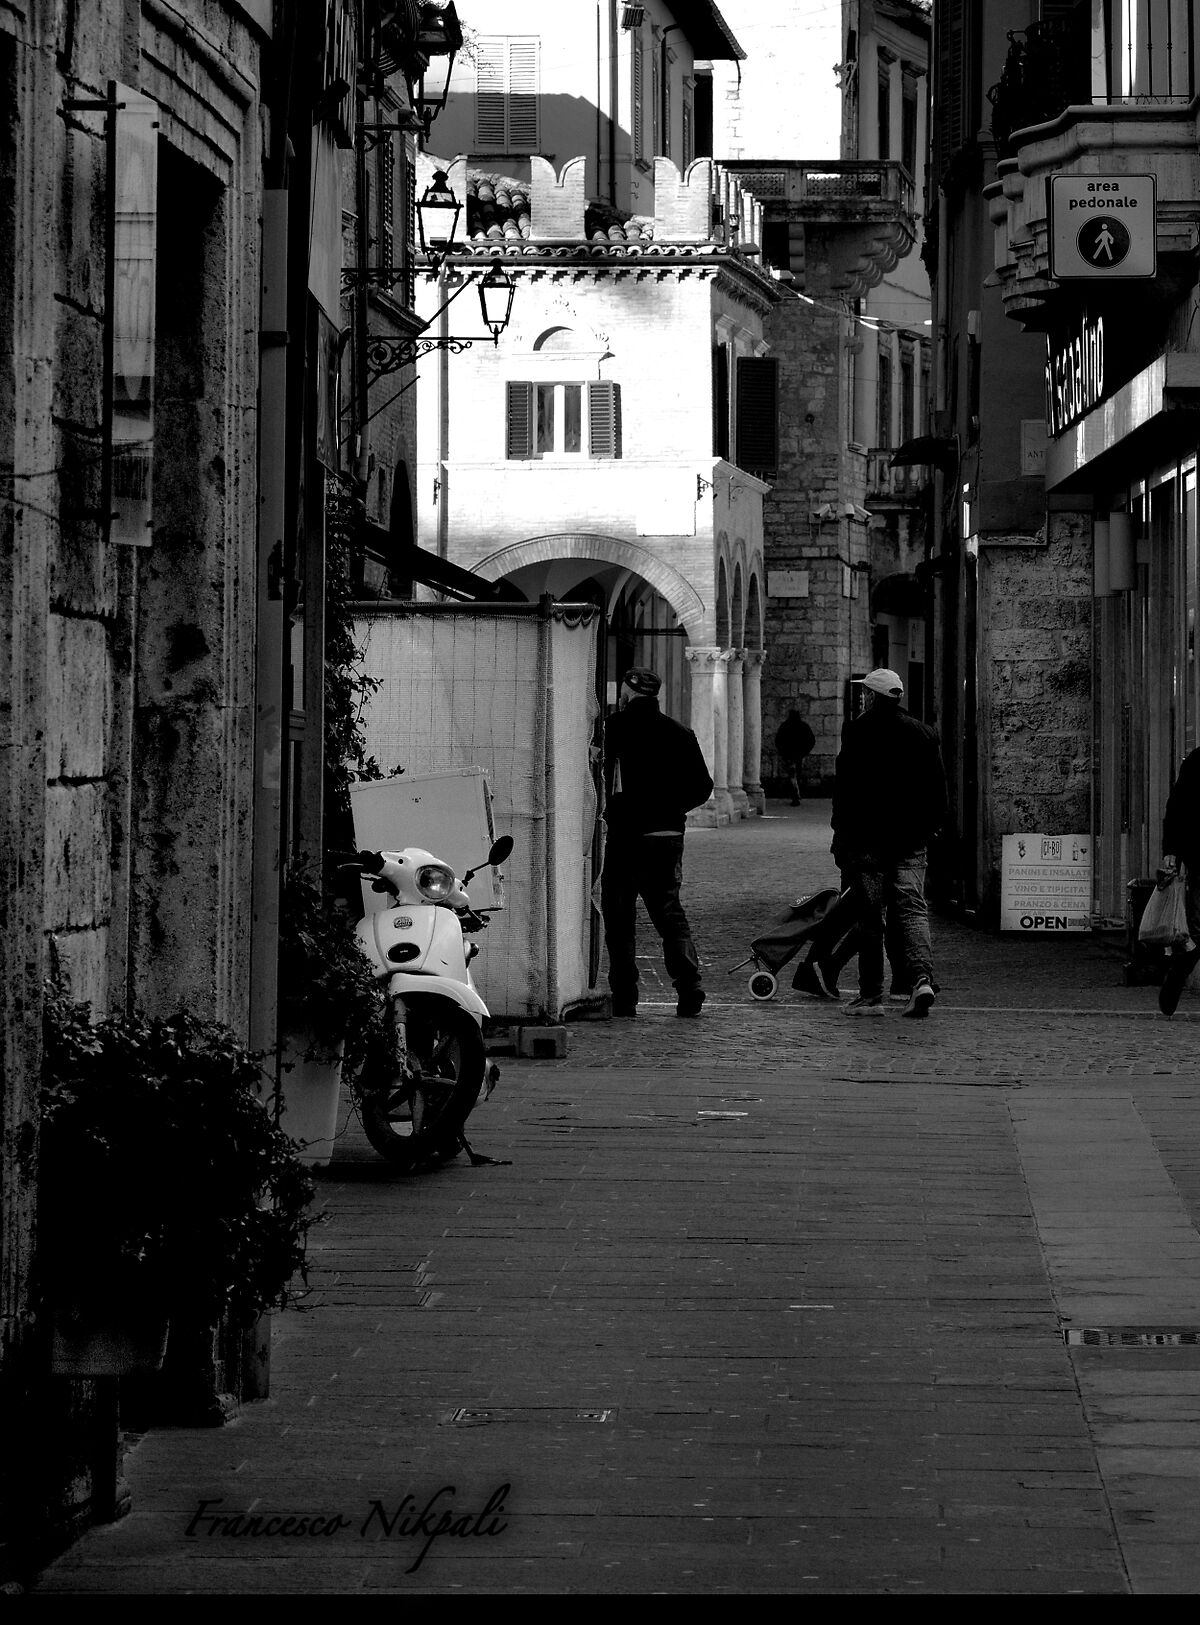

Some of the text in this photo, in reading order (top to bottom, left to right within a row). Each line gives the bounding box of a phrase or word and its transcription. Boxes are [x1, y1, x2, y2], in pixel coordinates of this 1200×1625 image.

[1087, 182, 1120, 192] area
[1069, 197, 1138, 210] pedonale
[1008, 868, 1041, 876] PANINI
[1014, 885, 1038, 893] VINO
[1061, 901, 1086, 909] CENA
[1020, 916, 1067, 929] OPEN
